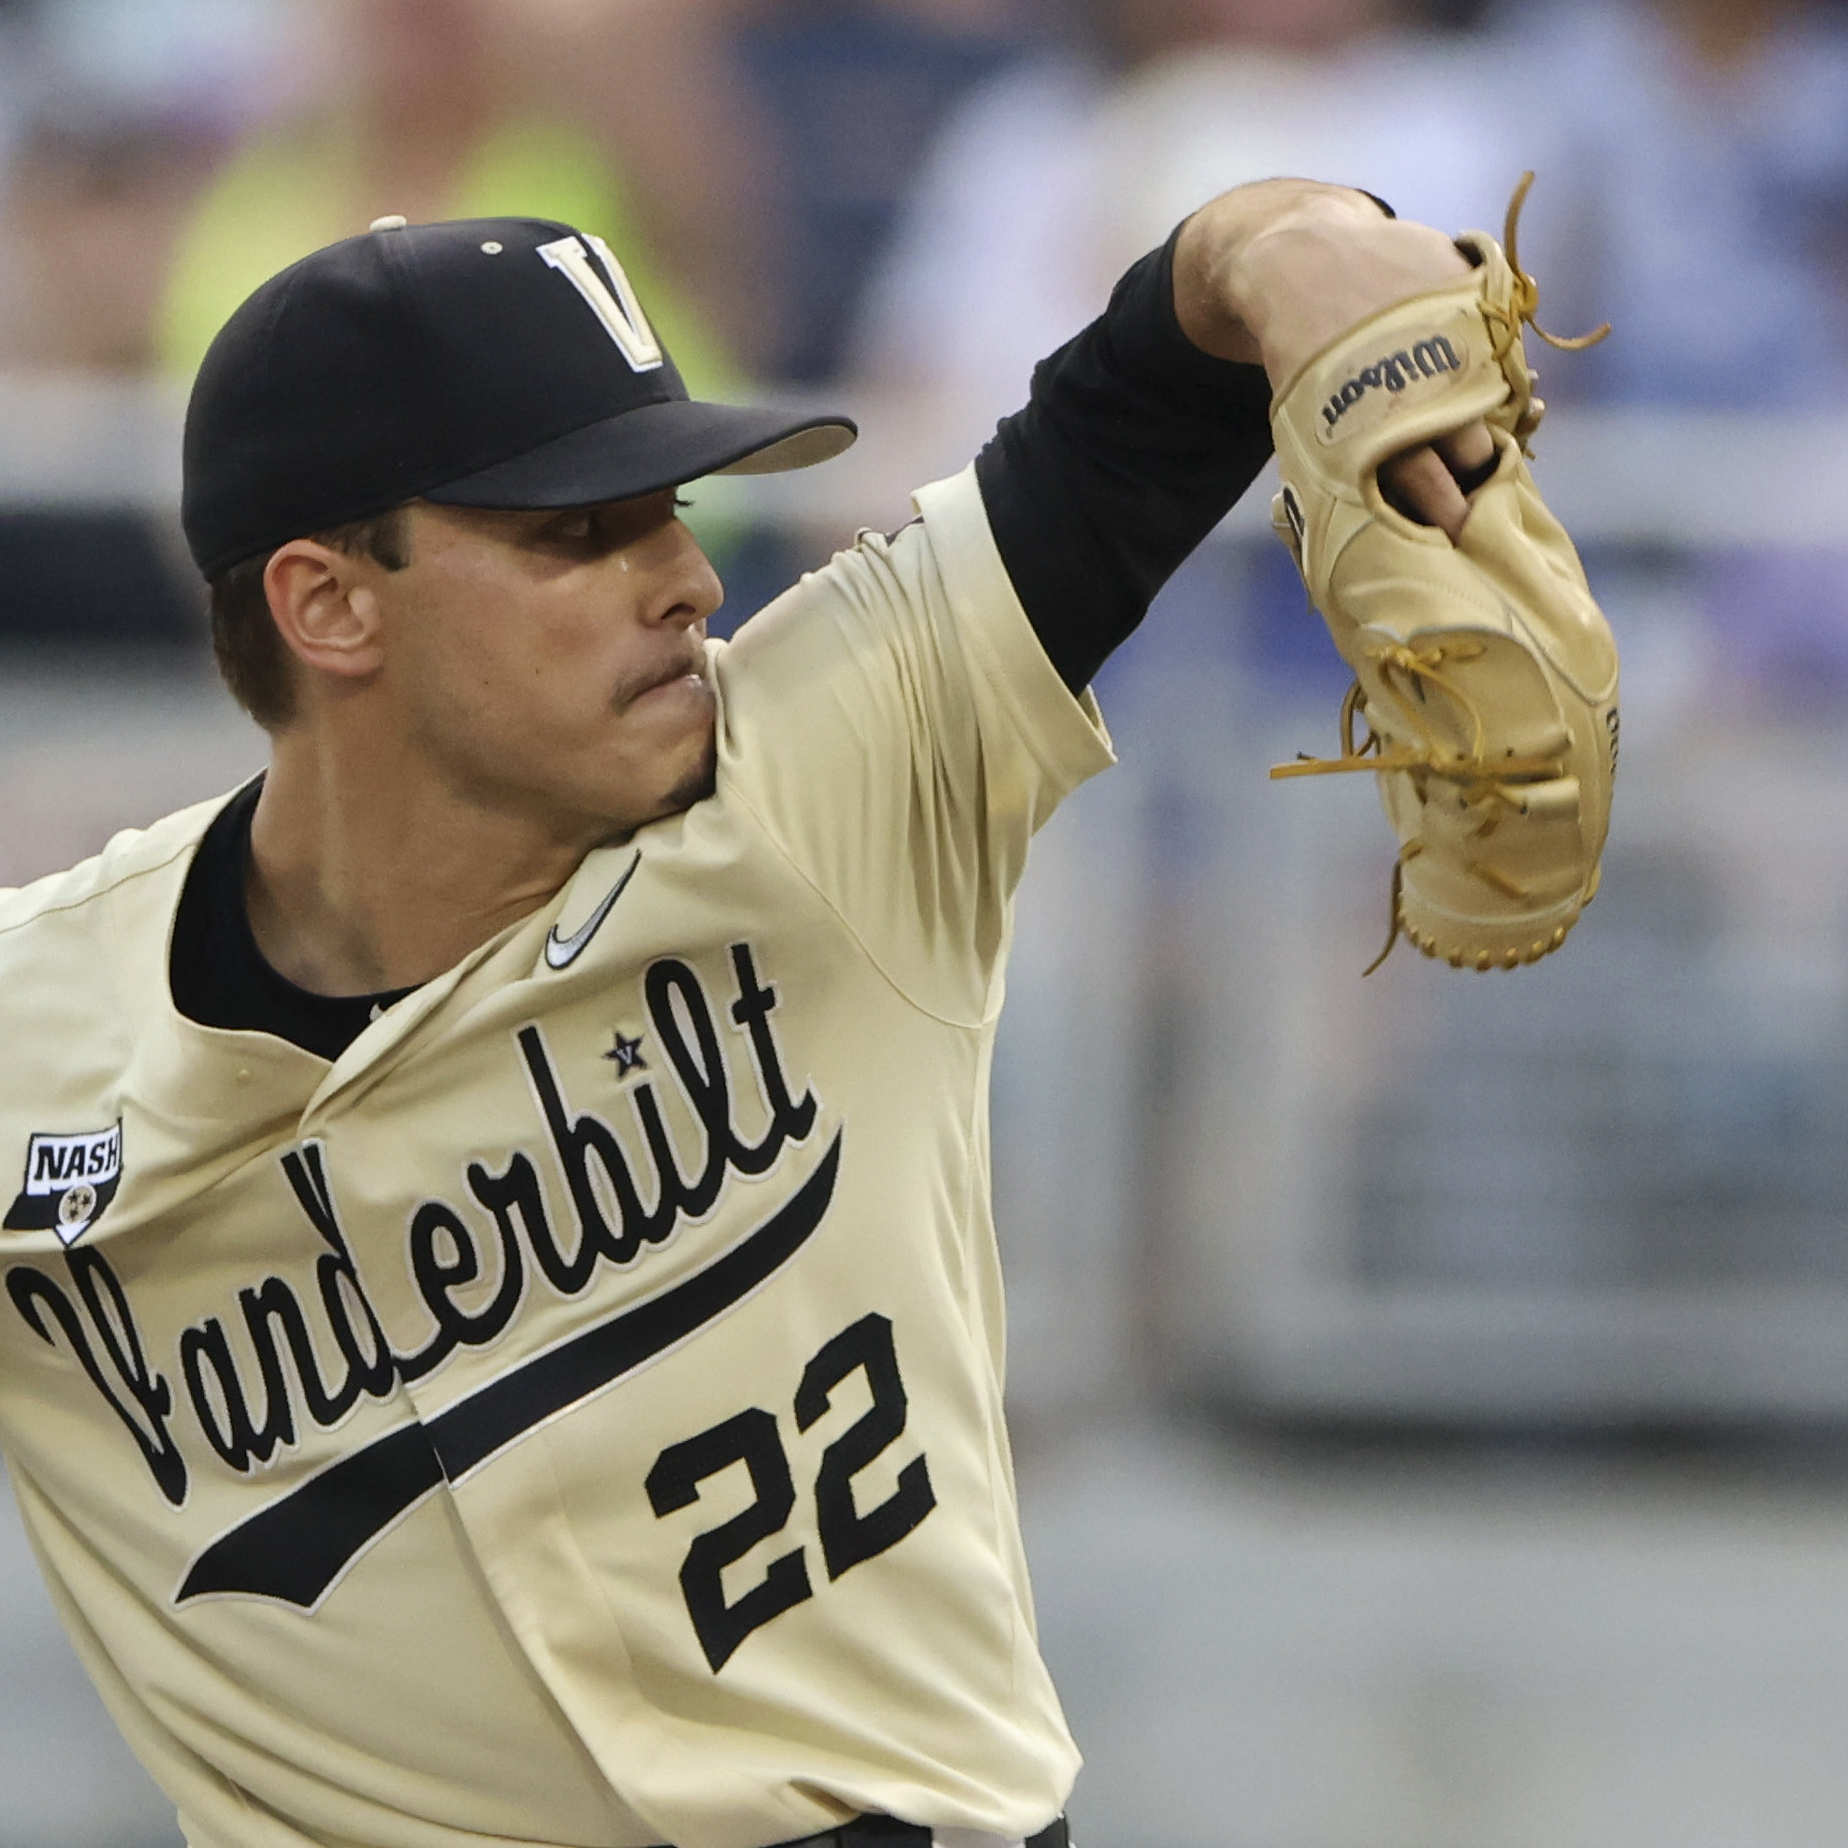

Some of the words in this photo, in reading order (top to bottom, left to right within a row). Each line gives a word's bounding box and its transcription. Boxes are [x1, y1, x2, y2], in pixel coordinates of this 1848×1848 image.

[536, 233, 663, 373] V
[1322, 336, 1460, 426] Wilson
[4, 942, 817, 1508] Vanderbilt
[35, 1134, 119, 1180] NASH
[645, 1313, 936, 1674] 22
